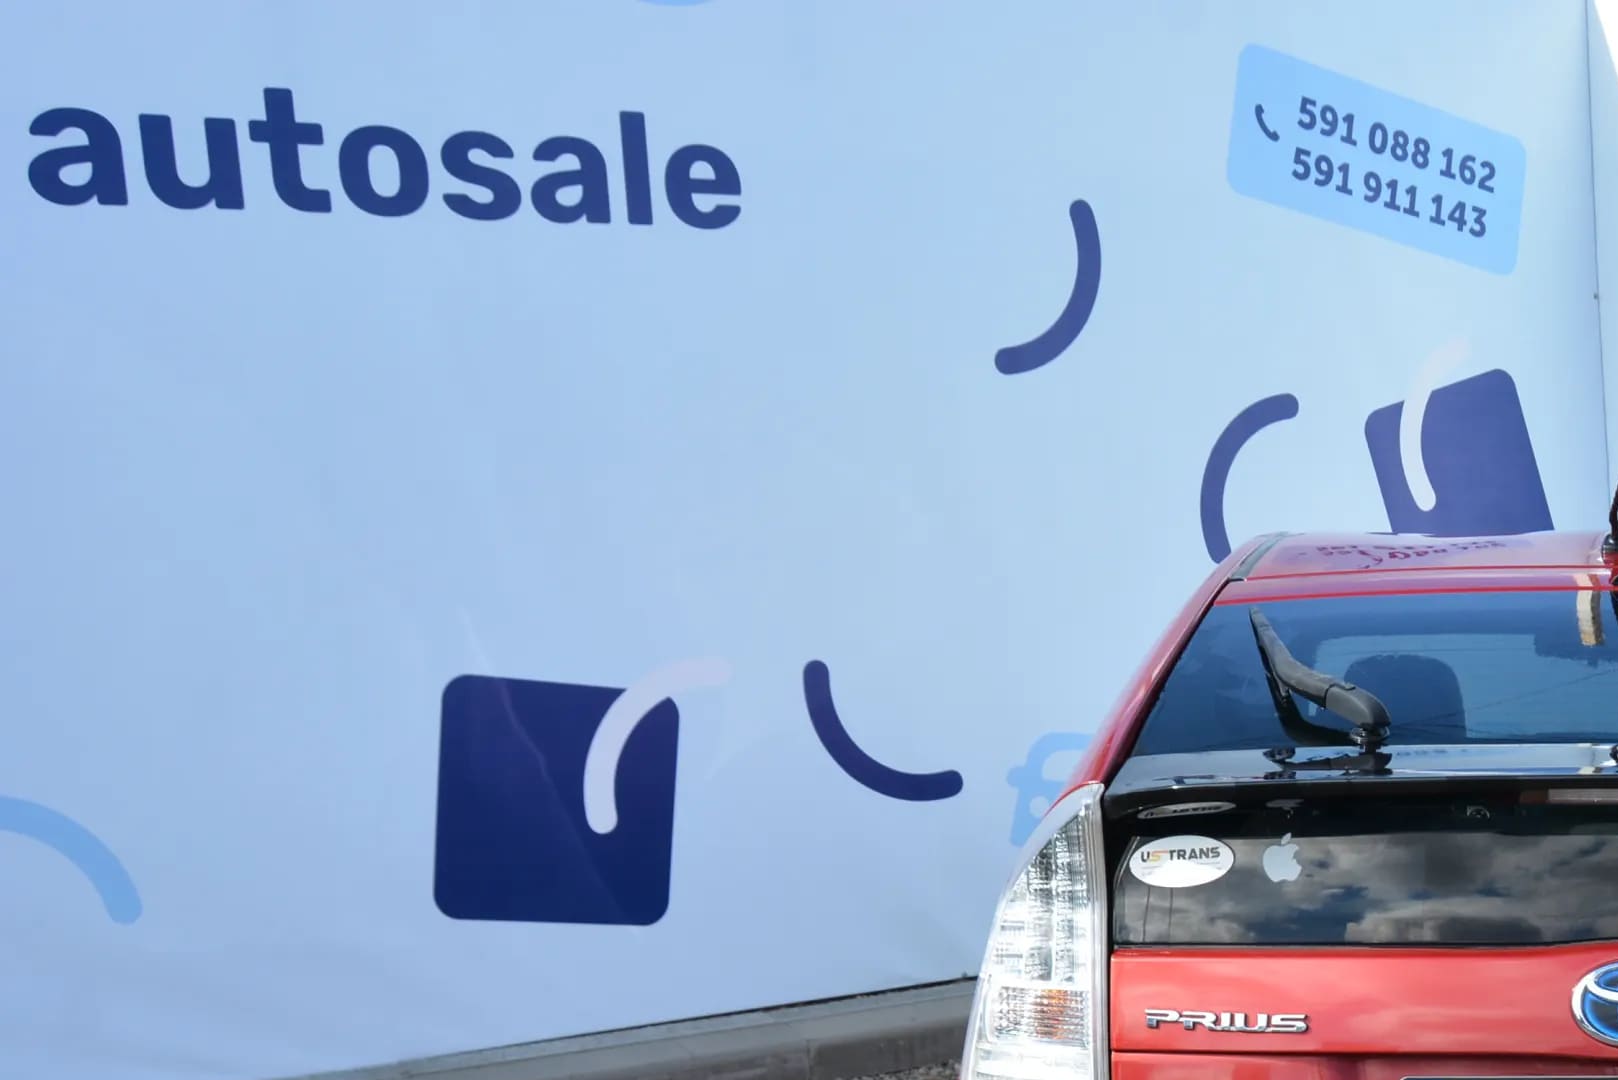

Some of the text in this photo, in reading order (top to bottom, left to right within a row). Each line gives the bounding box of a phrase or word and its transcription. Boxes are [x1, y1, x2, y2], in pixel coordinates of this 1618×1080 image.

[27, 86, 742, 230] autosale
[1291, 146, 1488, 238] 591 911 143
[1297, 95, 1496, 194] 591 088 162
[1144, 1008, 1309, 1033] PRIUS
